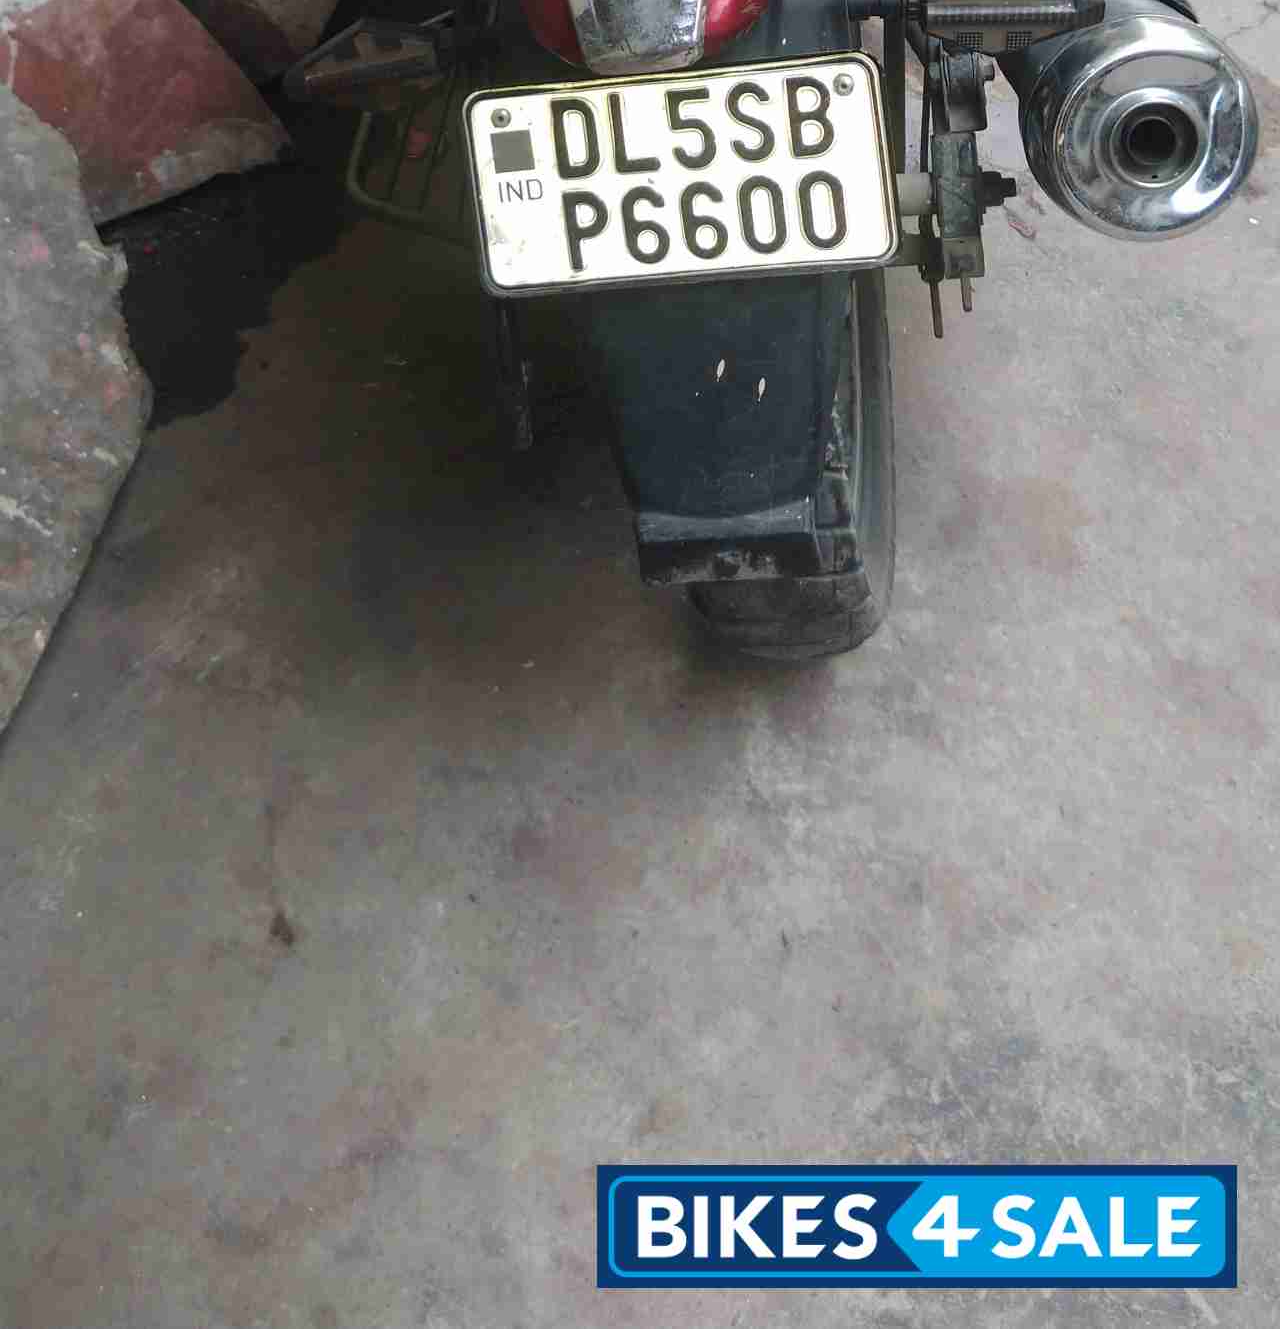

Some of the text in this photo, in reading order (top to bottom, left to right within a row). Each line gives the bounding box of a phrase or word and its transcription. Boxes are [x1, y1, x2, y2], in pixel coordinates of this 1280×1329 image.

[550, 76, 835, 179] DL5SB
[498, 178, 543, 202] IND
[562, 170, 847, 271] P6600
